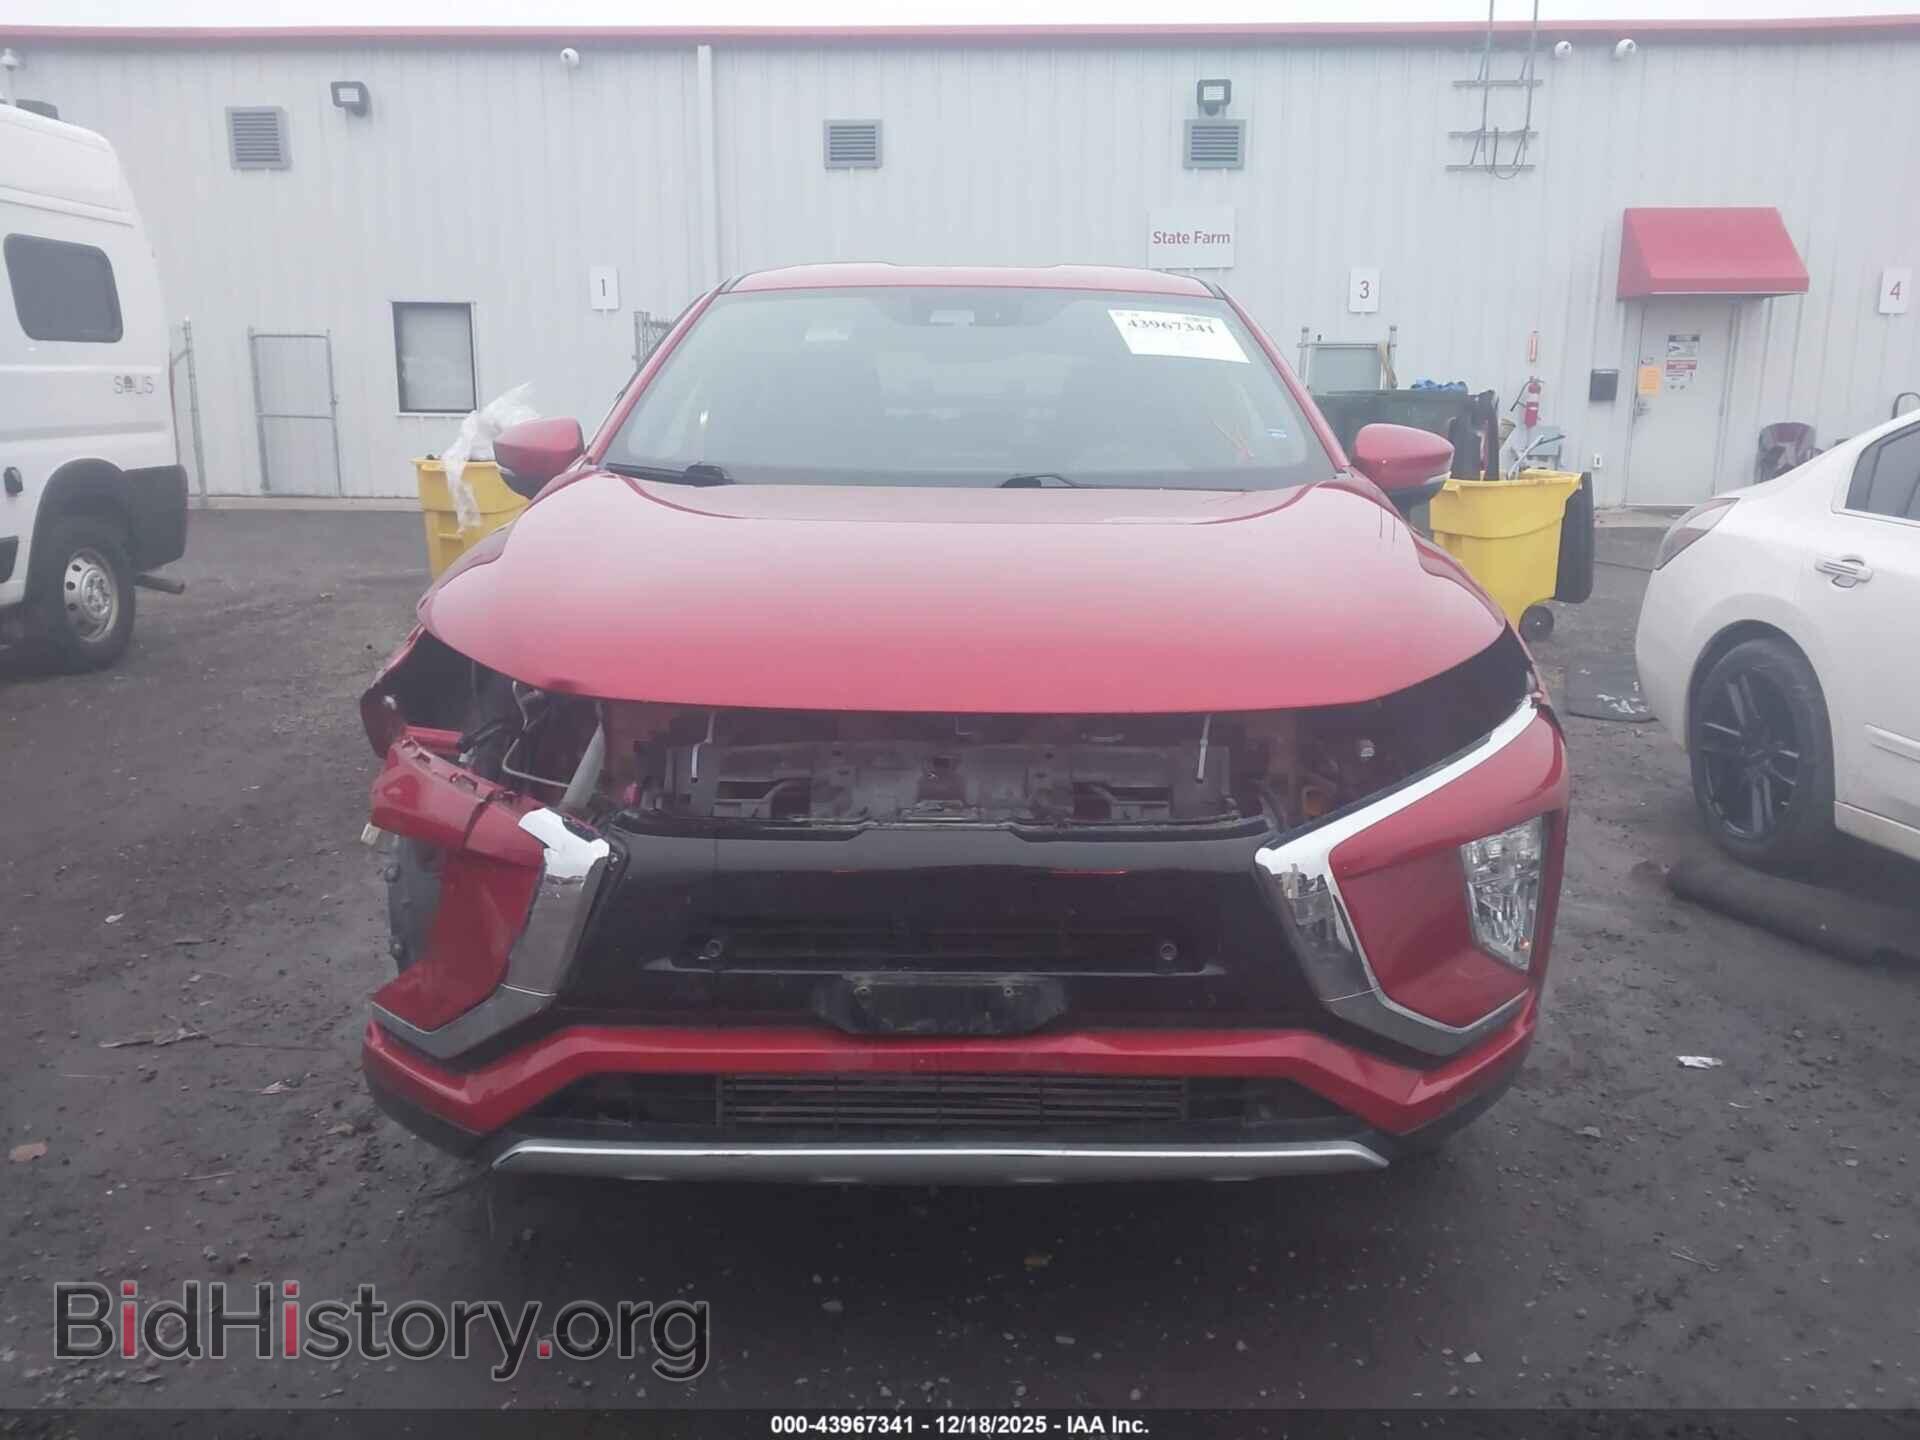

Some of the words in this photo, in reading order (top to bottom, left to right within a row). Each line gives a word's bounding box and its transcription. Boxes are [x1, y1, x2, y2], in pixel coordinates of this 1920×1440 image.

[1152, 230, 1190, 245] State
[1193, 230, 1231, 245] Farm
[1359, 280, 1370, 299] 3
[1889, 281, 1901, 301] 4
